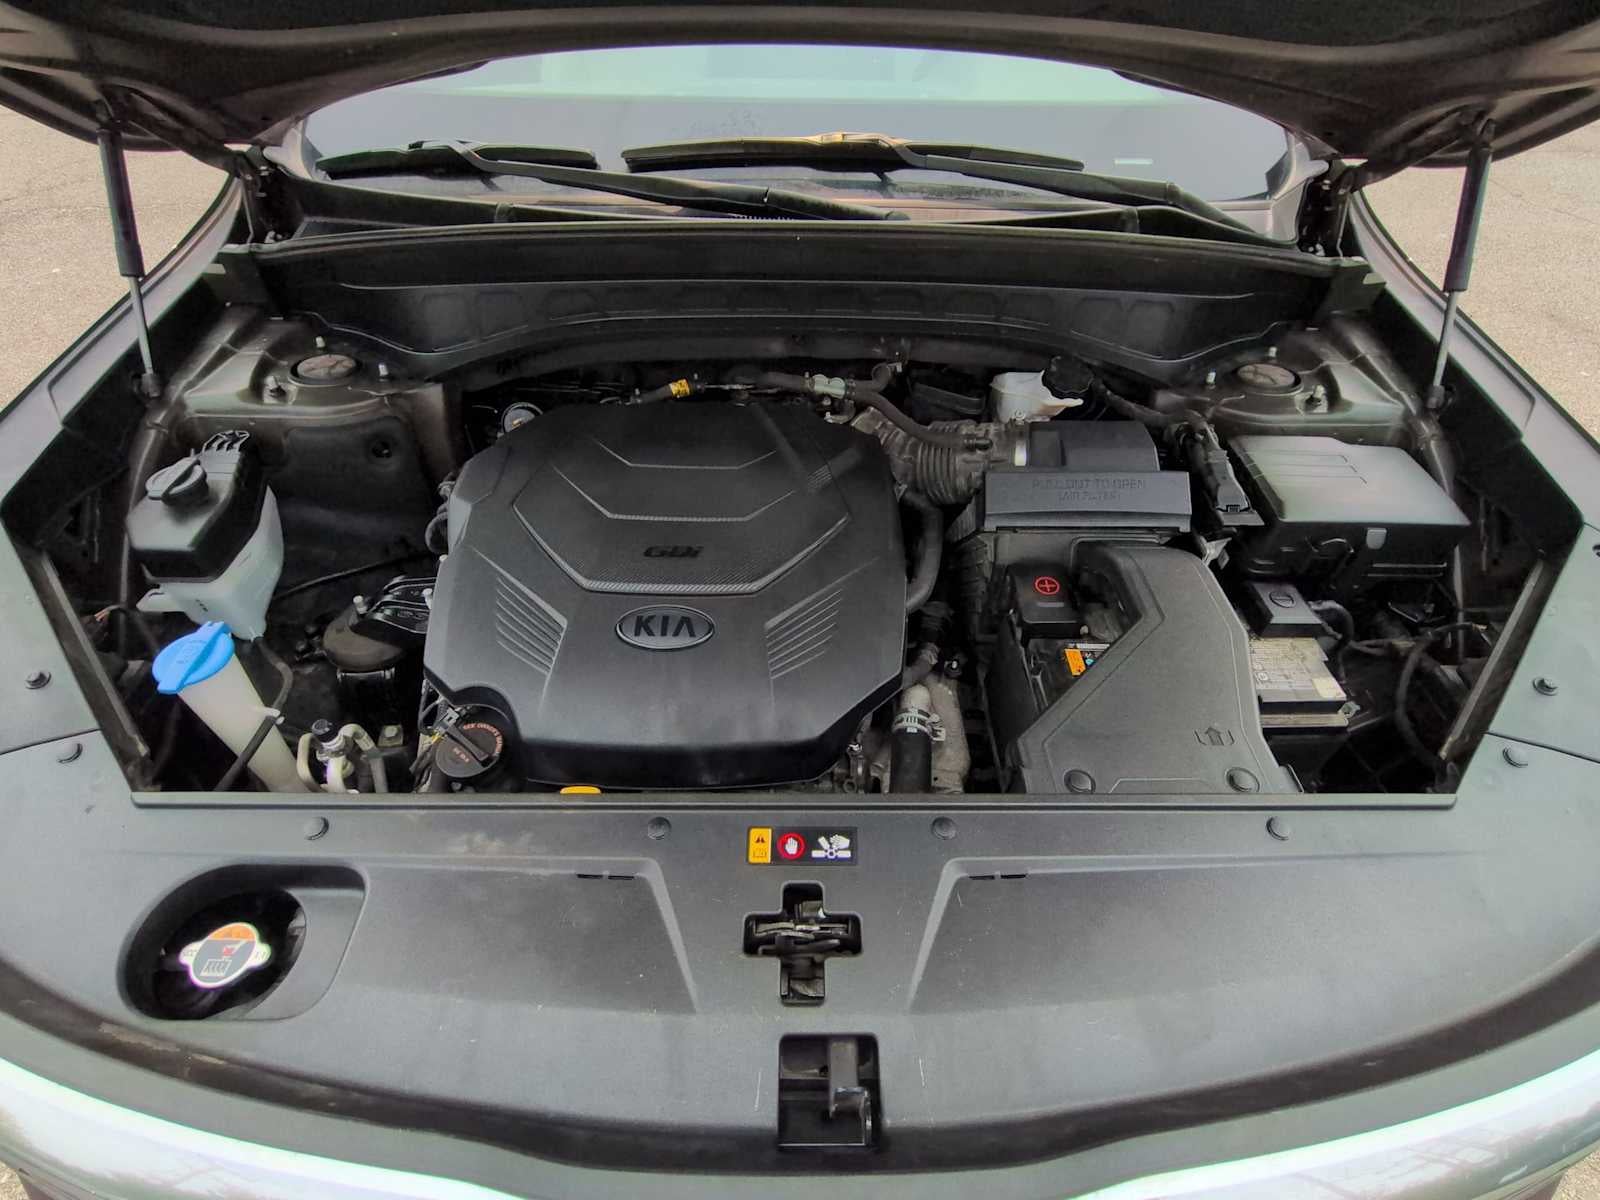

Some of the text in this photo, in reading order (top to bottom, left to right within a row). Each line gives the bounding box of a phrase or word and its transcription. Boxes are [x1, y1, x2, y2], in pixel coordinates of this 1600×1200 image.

[1067, 479, 1091, 489] OUT
[1095, 479, 1110, 489] TO
[1113, 479, 1147, 490] OPEN
[634, 615, 697, 638] KIA
